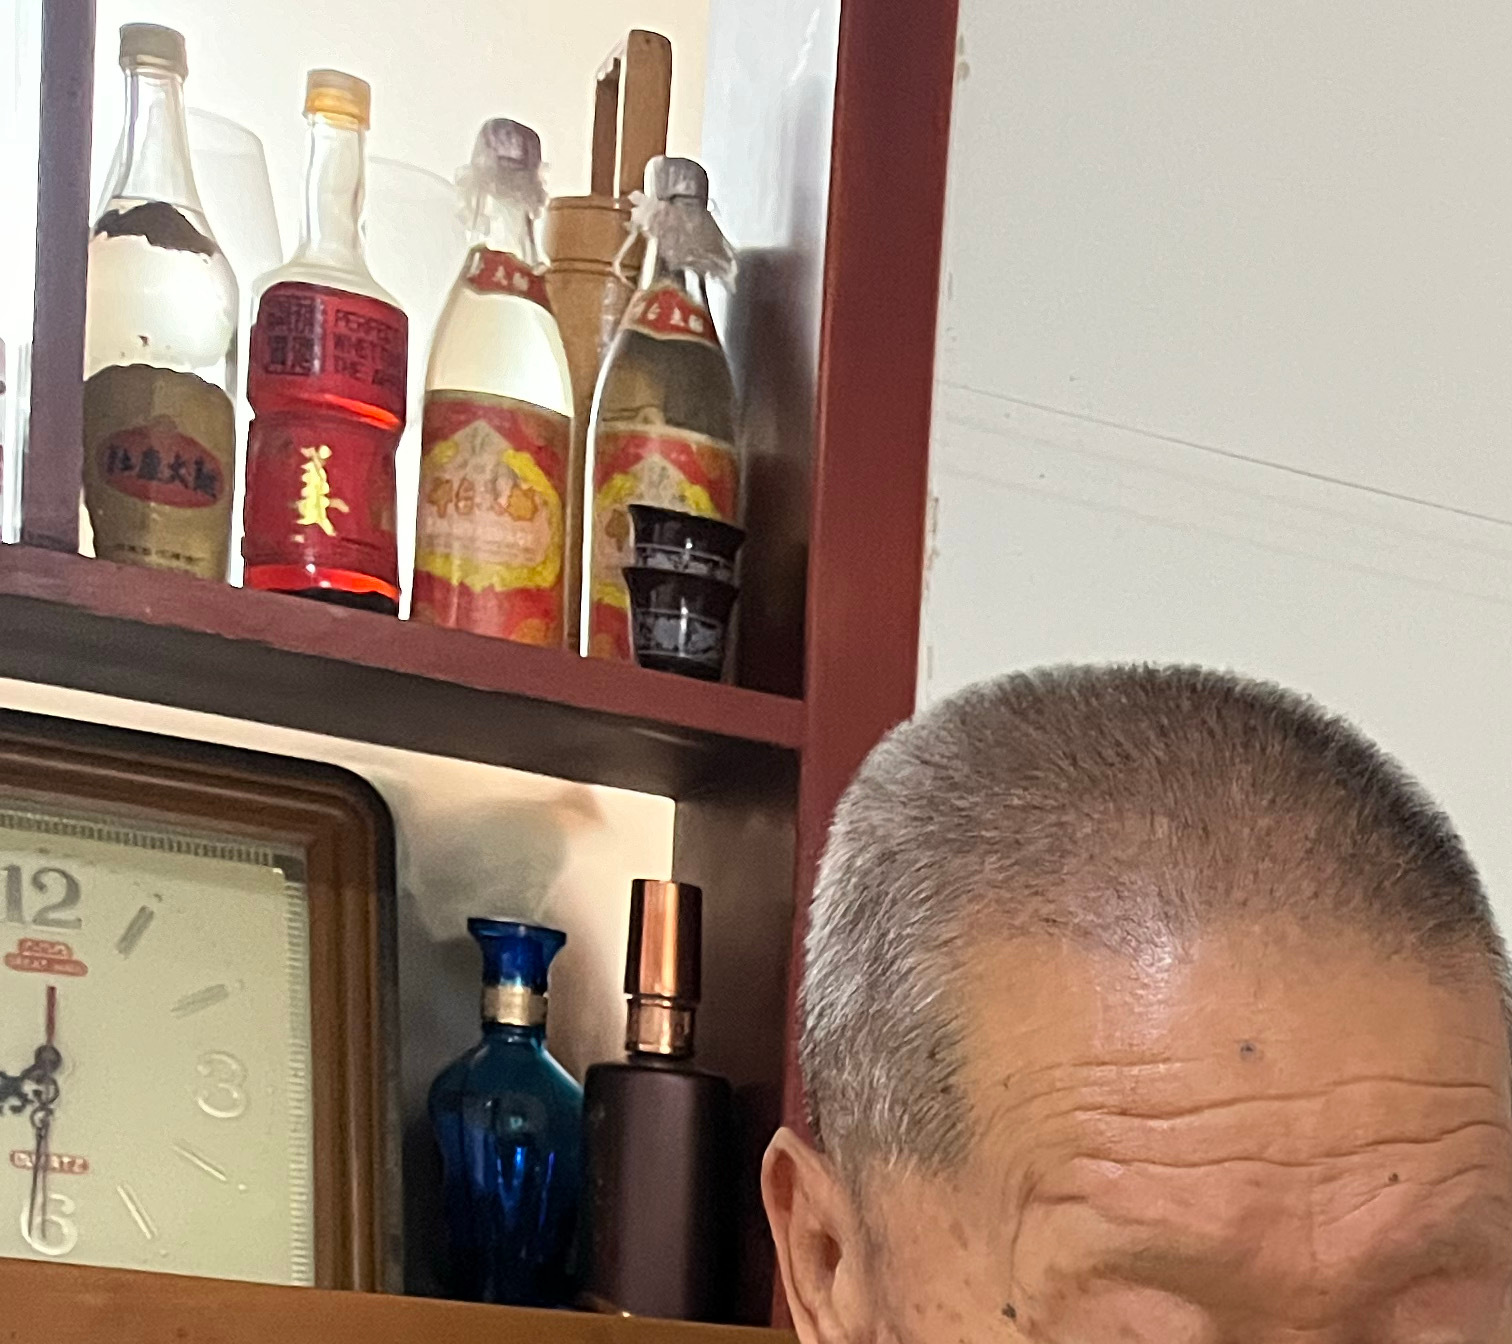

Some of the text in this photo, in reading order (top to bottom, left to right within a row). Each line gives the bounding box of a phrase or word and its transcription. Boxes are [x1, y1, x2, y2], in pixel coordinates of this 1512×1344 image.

[1, 864, 83, 929] 12
[197, 1050, 249, 1119] 3
[20, 1192, 78, 1256] 6
